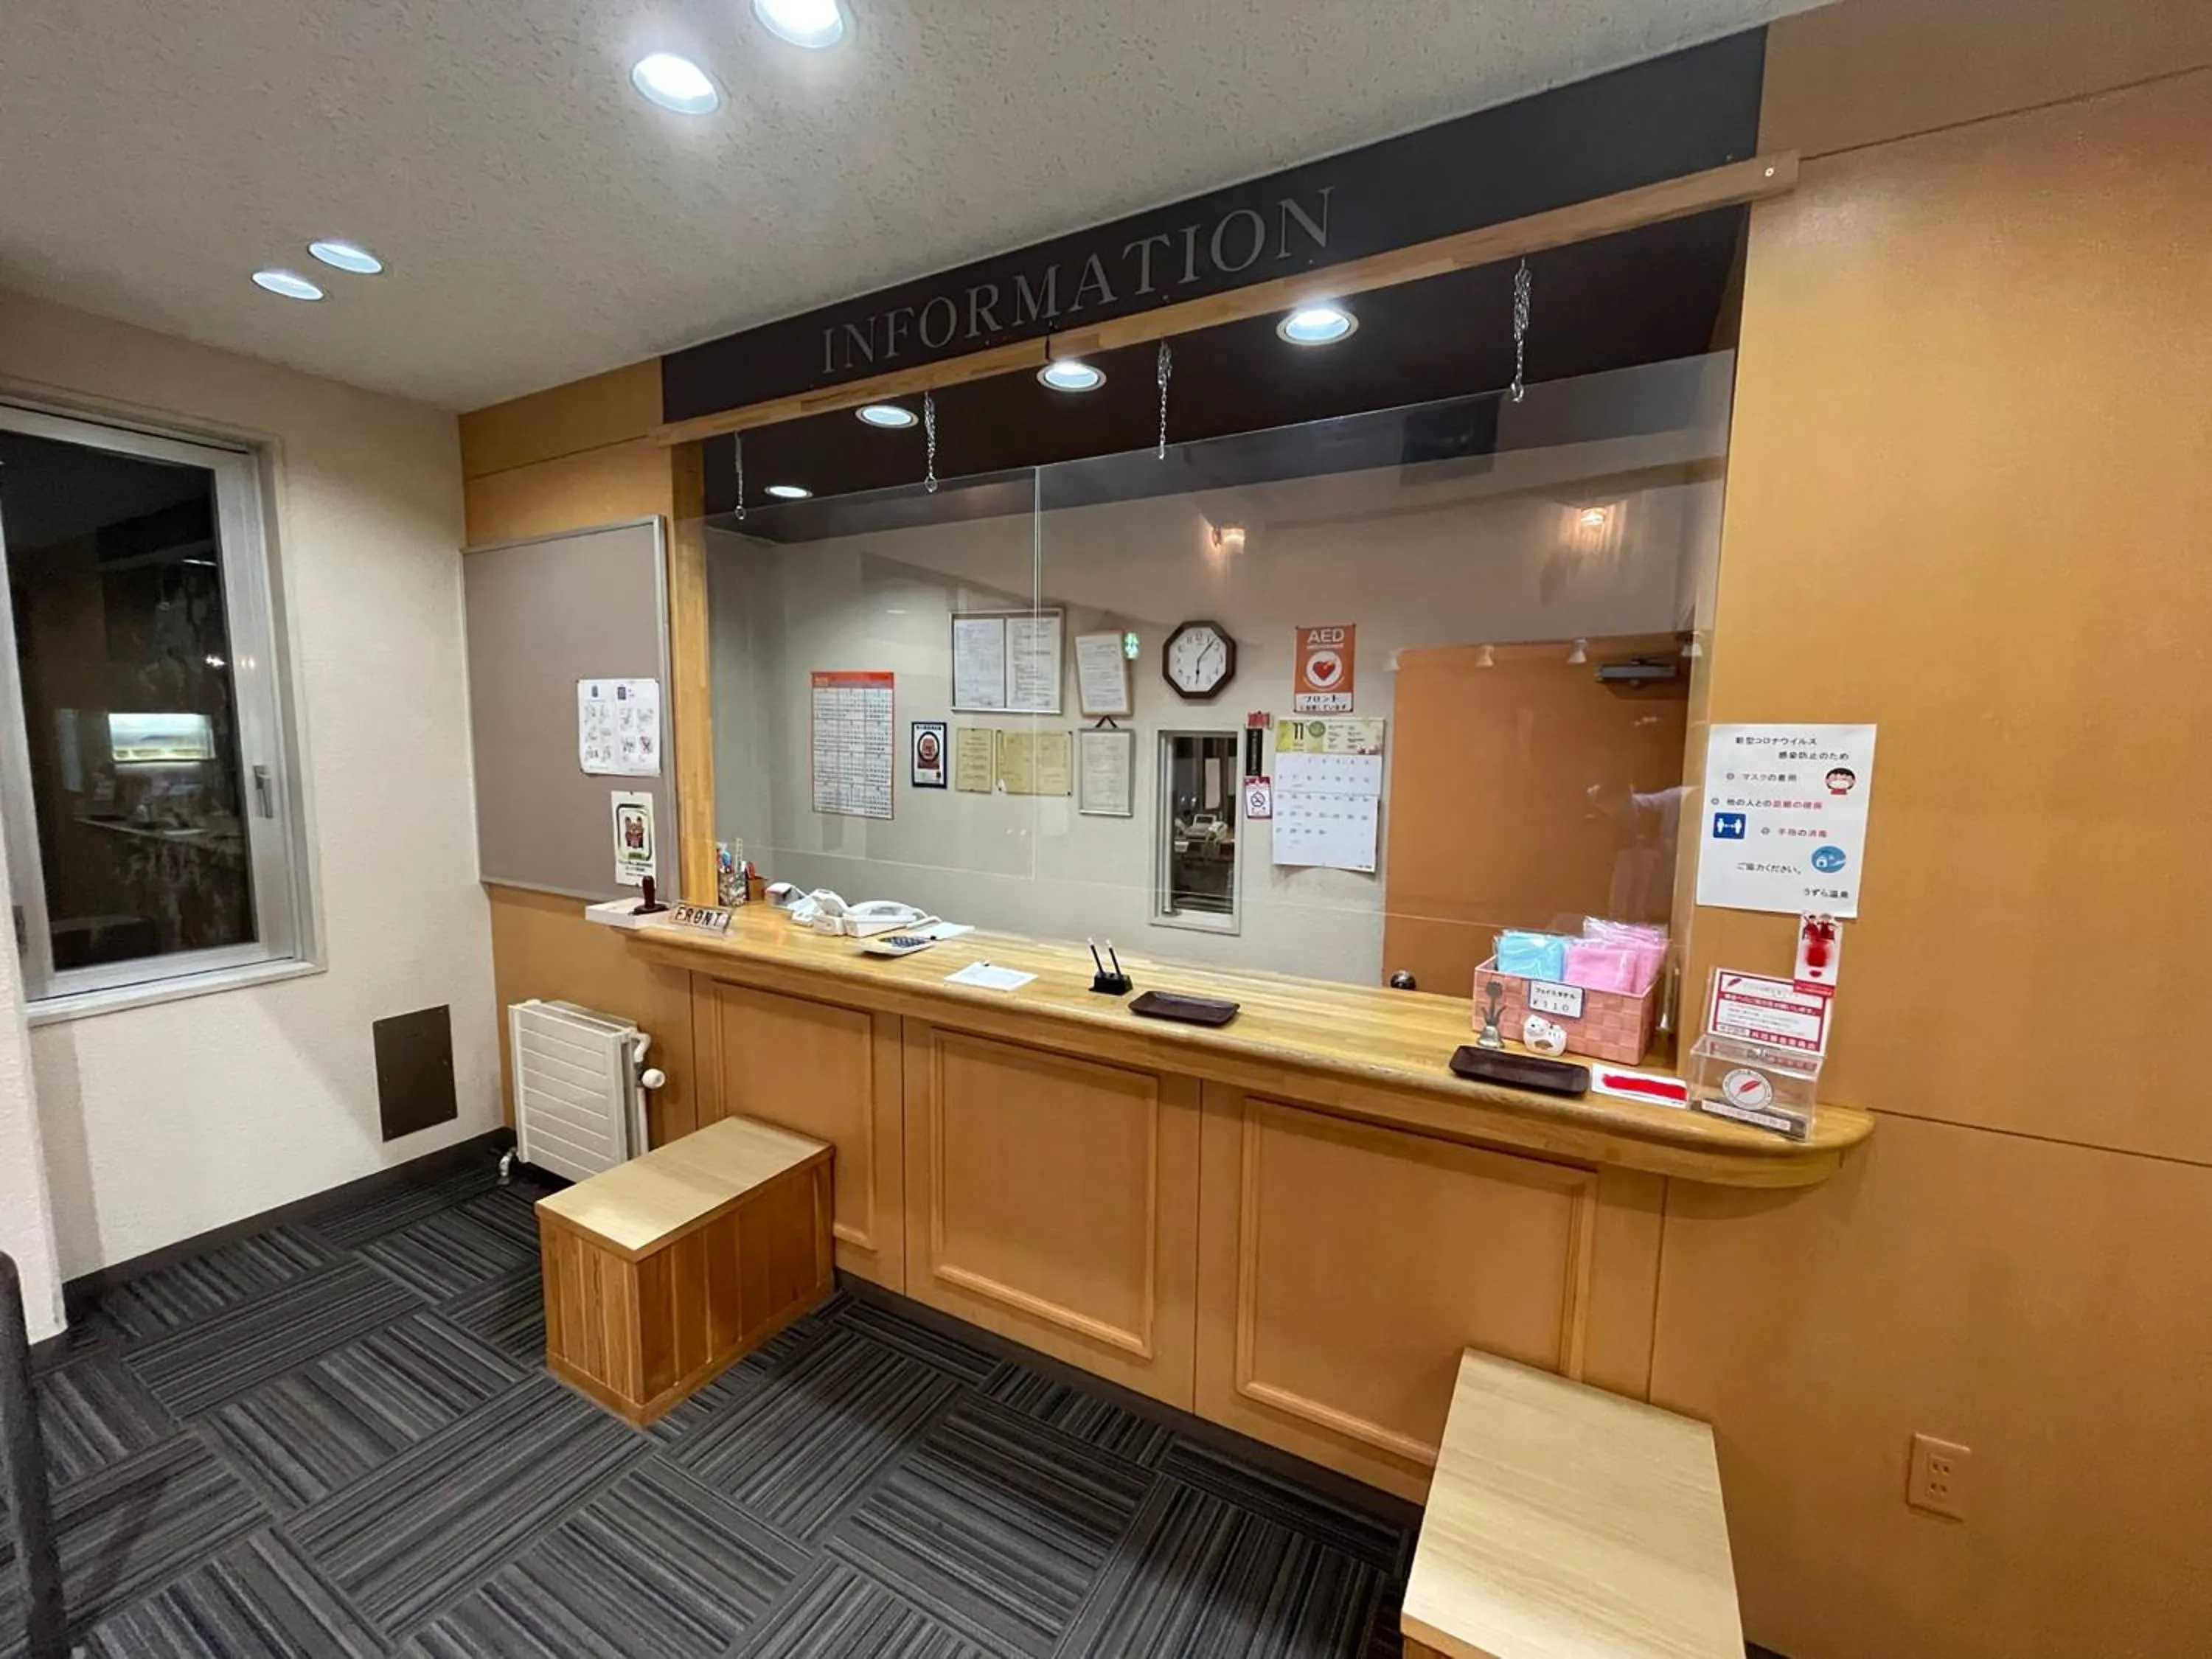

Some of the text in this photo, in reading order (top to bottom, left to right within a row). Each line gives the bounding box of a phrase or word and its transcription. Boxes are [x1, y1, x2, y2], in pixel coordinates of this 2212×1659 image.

[822, 187, 1334, 375] INFORMATION
[1307, 627, 1345, 644] AED
[1293, 722, 1304, 740] 11
[1778, 751, 1849, 760] 感染防止のため
[675, 906, 723, 927] FRONT
